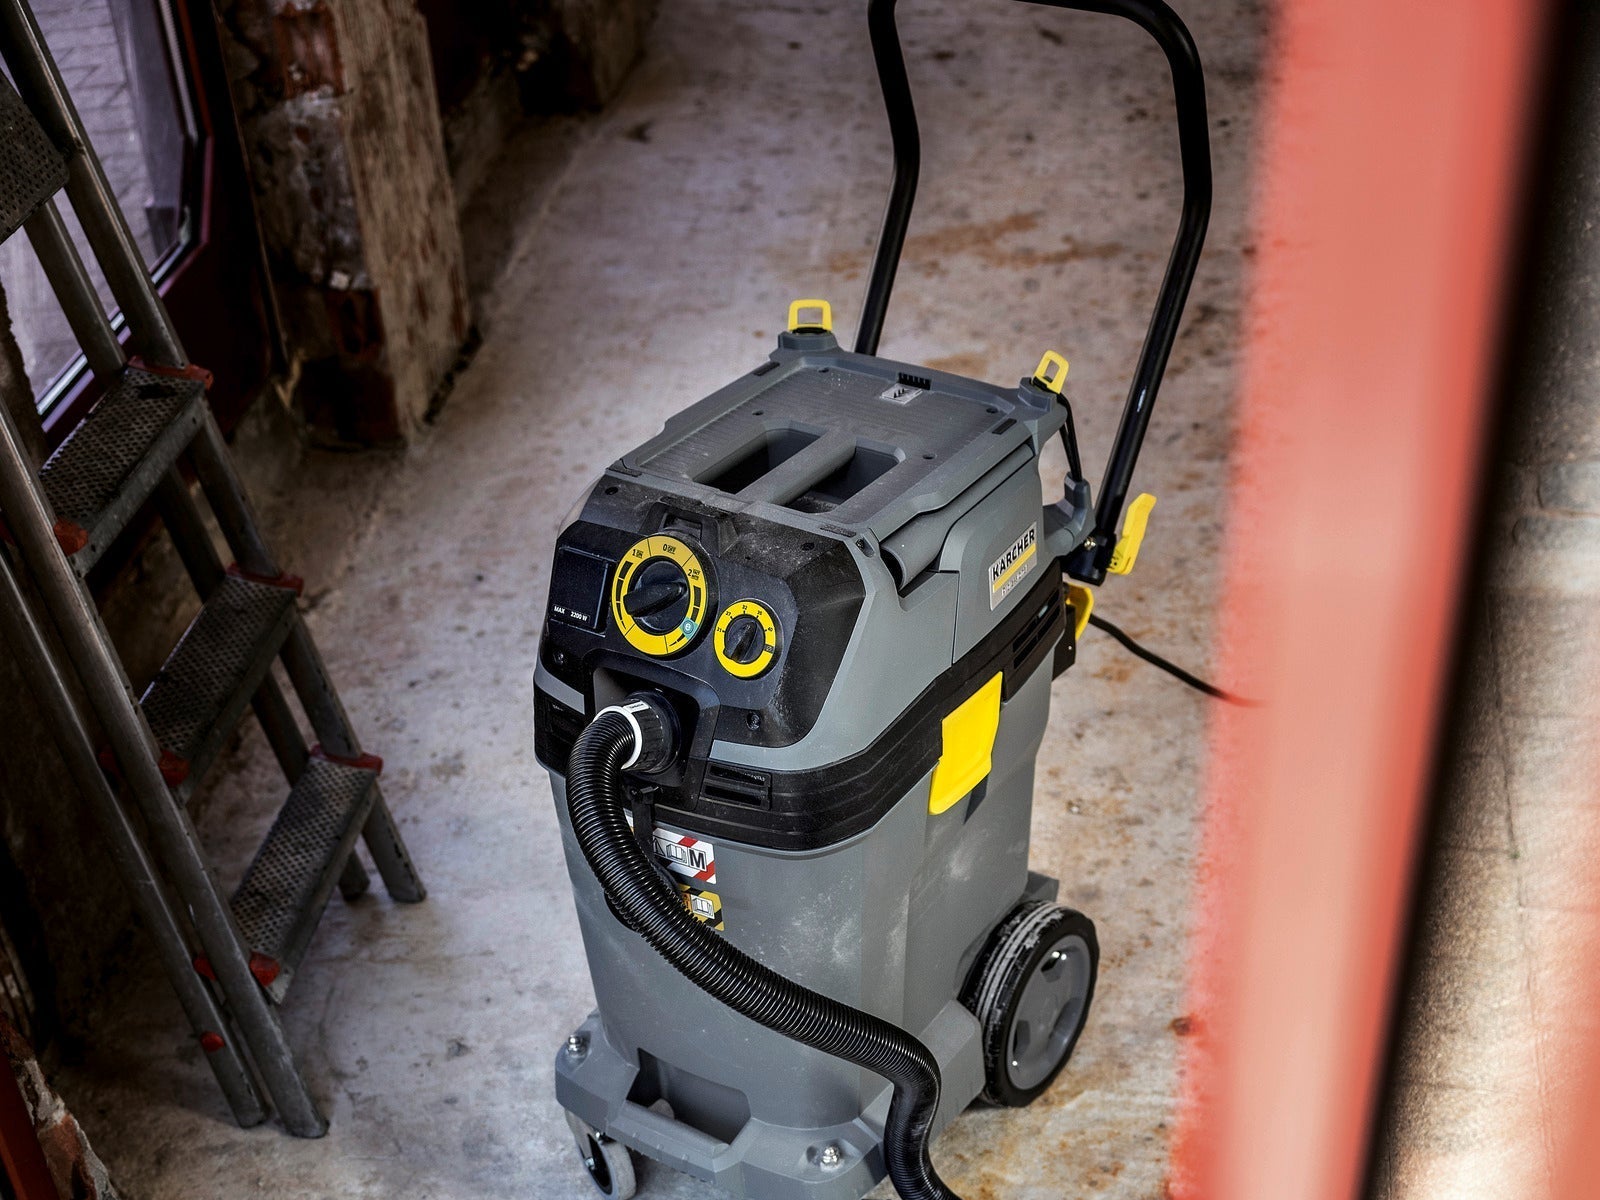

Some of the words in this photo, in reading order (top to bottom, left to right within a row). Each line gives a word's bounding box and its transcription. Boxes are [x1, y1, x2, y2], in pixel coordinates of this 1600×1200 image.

[662, 543, 668, 552] 0
[992, 528, 1035, 581] KÄRCHER
[687, 568, 693, 577] 2
[554, 605, 566, 615] MAX
[570, 611, 583, 621] 2200
[689, 848, 706, 870] M
